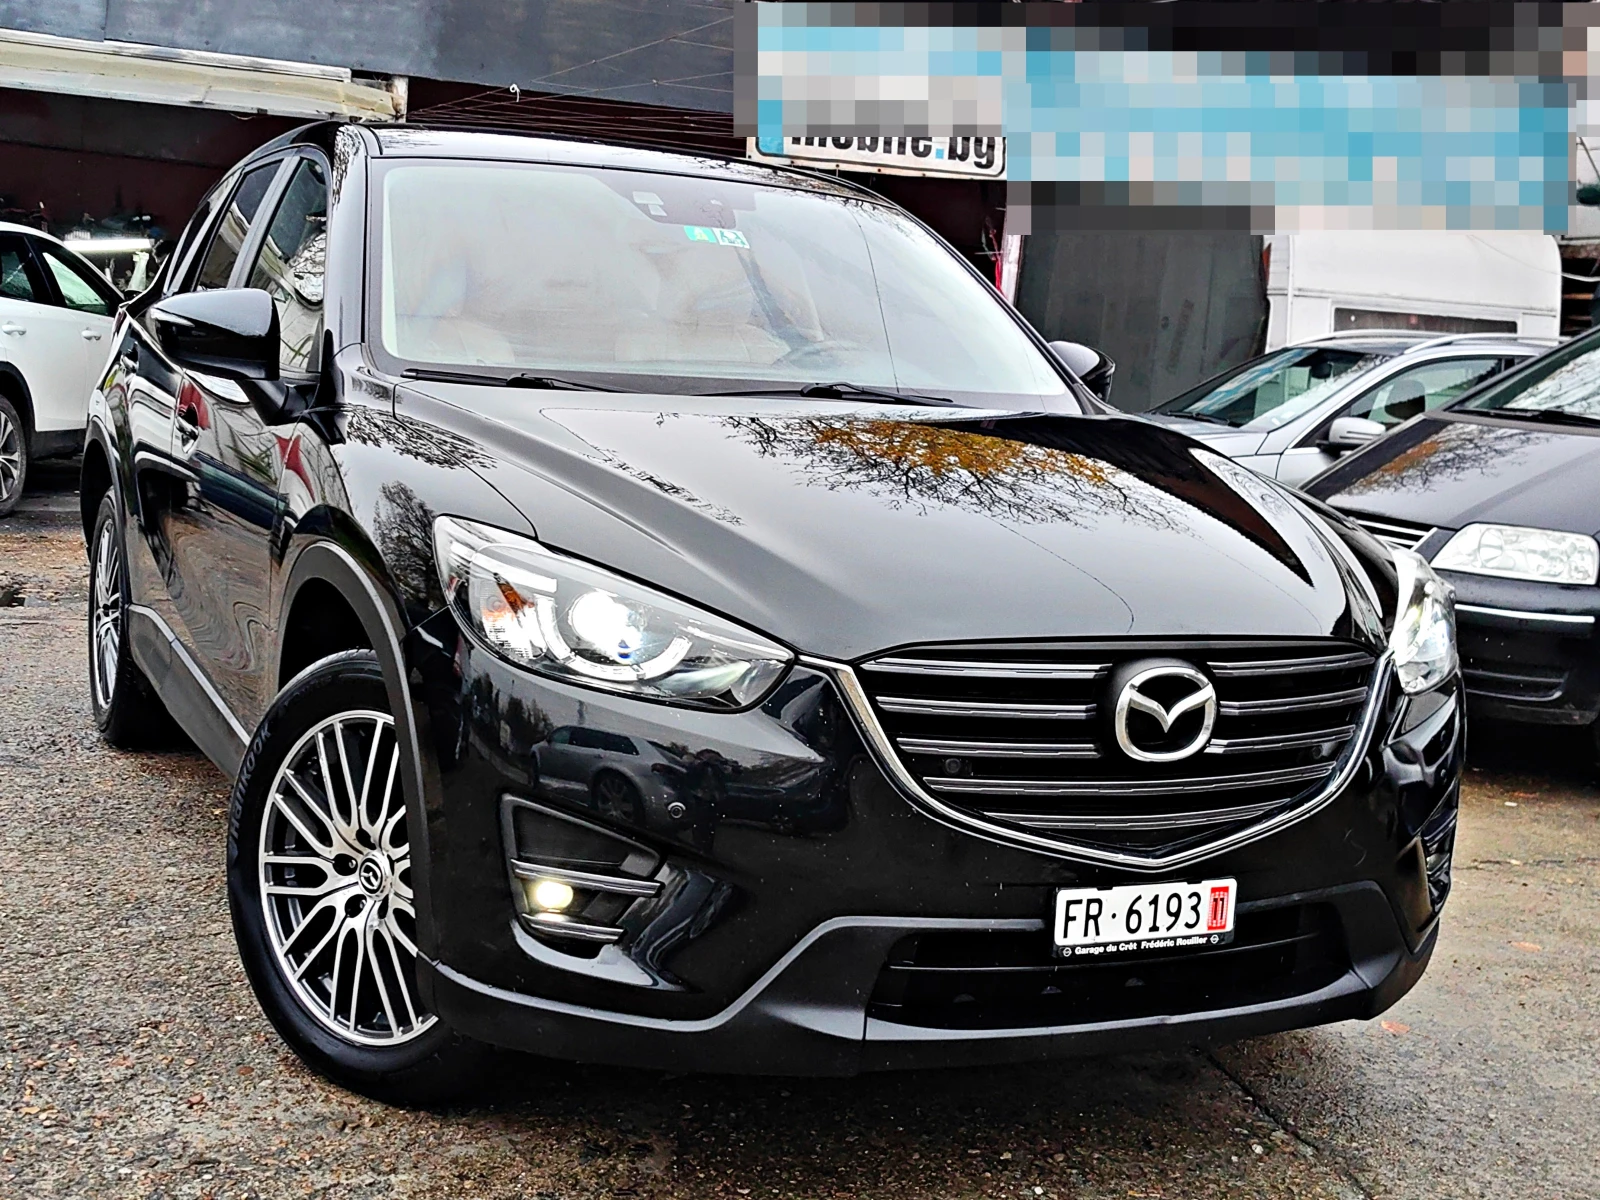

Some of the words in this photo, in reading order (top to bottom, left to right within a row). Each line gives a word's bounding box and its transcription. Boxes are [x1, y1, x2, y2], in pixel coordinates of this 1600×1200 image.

[791, 137, 995, 169] le.bg
[1074, 946, 1104, 956] Garage
[1106, 945, 1117, 953] du
[1119, 942, 1137, 952] Crêt
[1140, 939, 1175, 950] Frédéric
